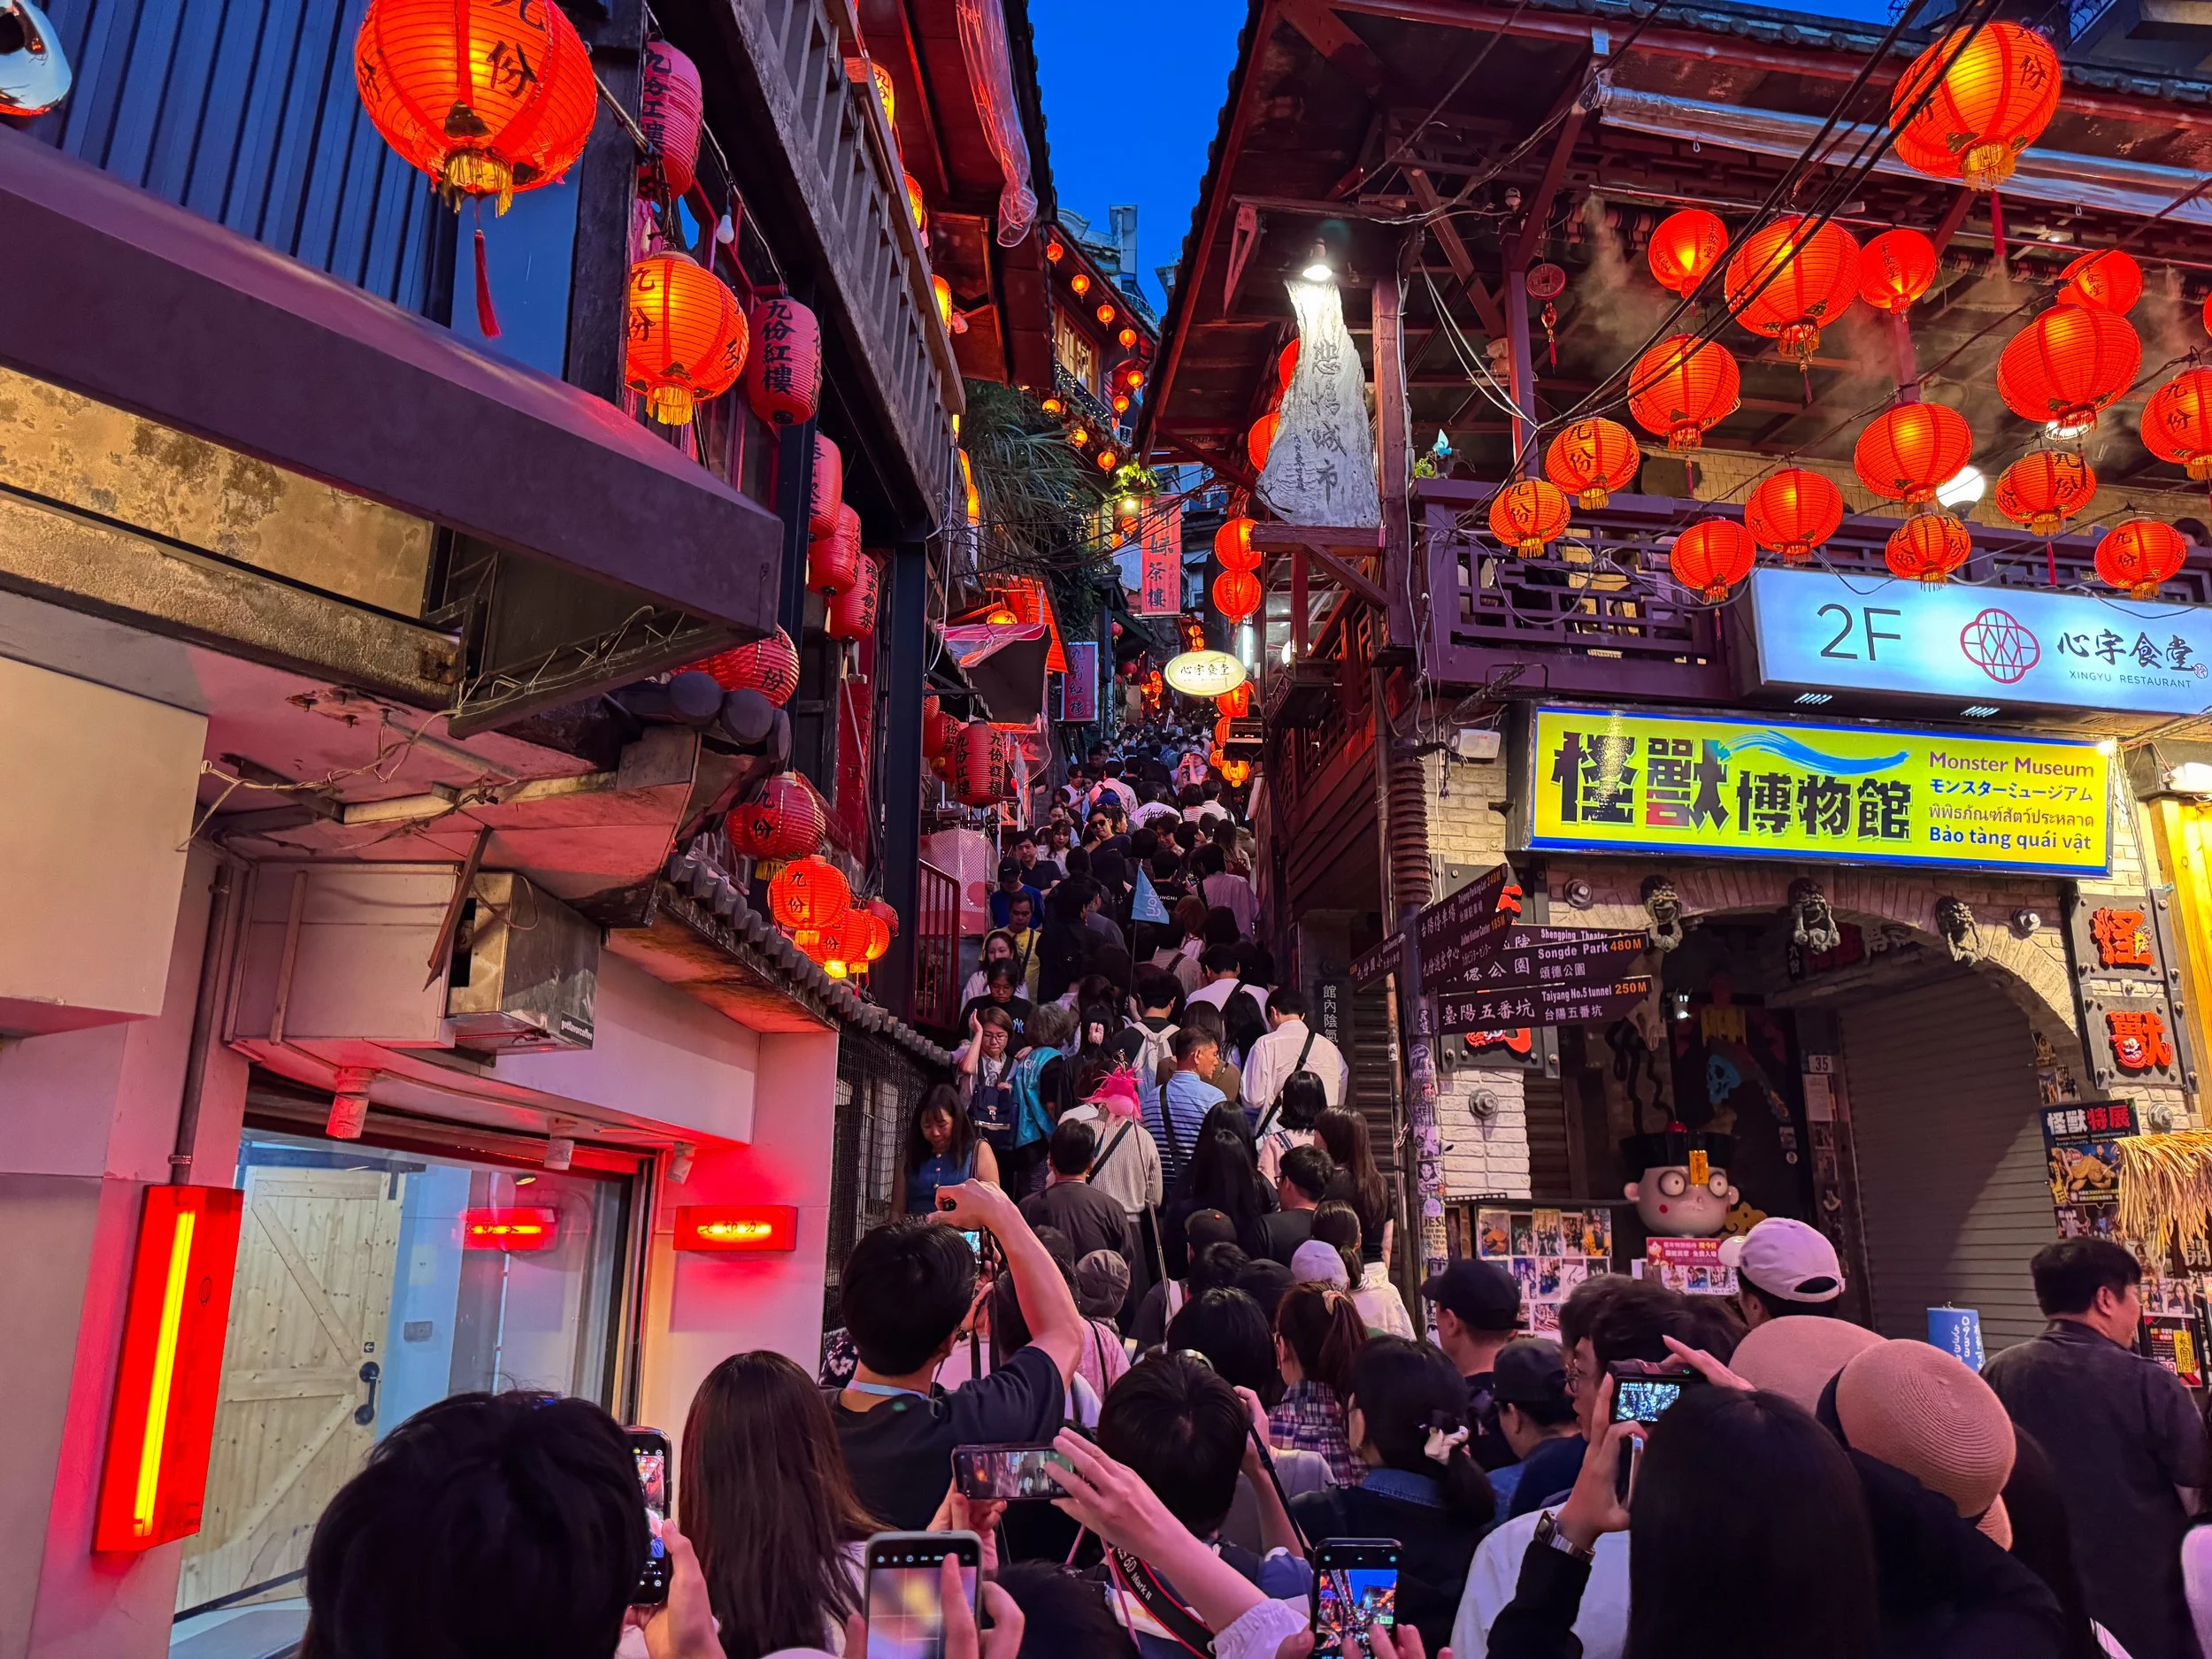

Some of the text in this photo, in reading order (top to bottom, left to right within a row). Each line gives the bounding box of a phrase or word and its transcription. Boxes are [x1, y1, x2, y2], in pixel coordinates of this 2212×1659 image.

[759, 300, 795, 396] 九份紅樓
[2165, 384, 2193, 433] 九份
[1569, 424, 1595, 472] 九份
[1509, 484, 1533, 525] 九份
[2115, 532, 2138, 568] 九份
[1817, 603, 1902, 661] 2F
[2070, 669, 2192, 688] XINGYU RESTAURANT
[1929, 751, 2094, 778] Monster Museum
[1551, 731, 1913, 842] 怪獸博物館
[1930, 778, 2093, 802] モンスターミュージアム
[1930, 825, 2092, 854] Bảo tàng quái vật
[1538, 938, 1642, 961] Songde Park 480M
[1540, 928, 1576, 942] Shengping
[1541, 981, 1647, 1003] Taiyang No.5 tunnel 250M
[1442, 997, 1535, 1026] 臺陽五番坑
[1816, 1056, 1829, 1071] 35
[1123, 1556, 1138, 1573] 6D
[1131, 1571, 1148, 1595] Mark
